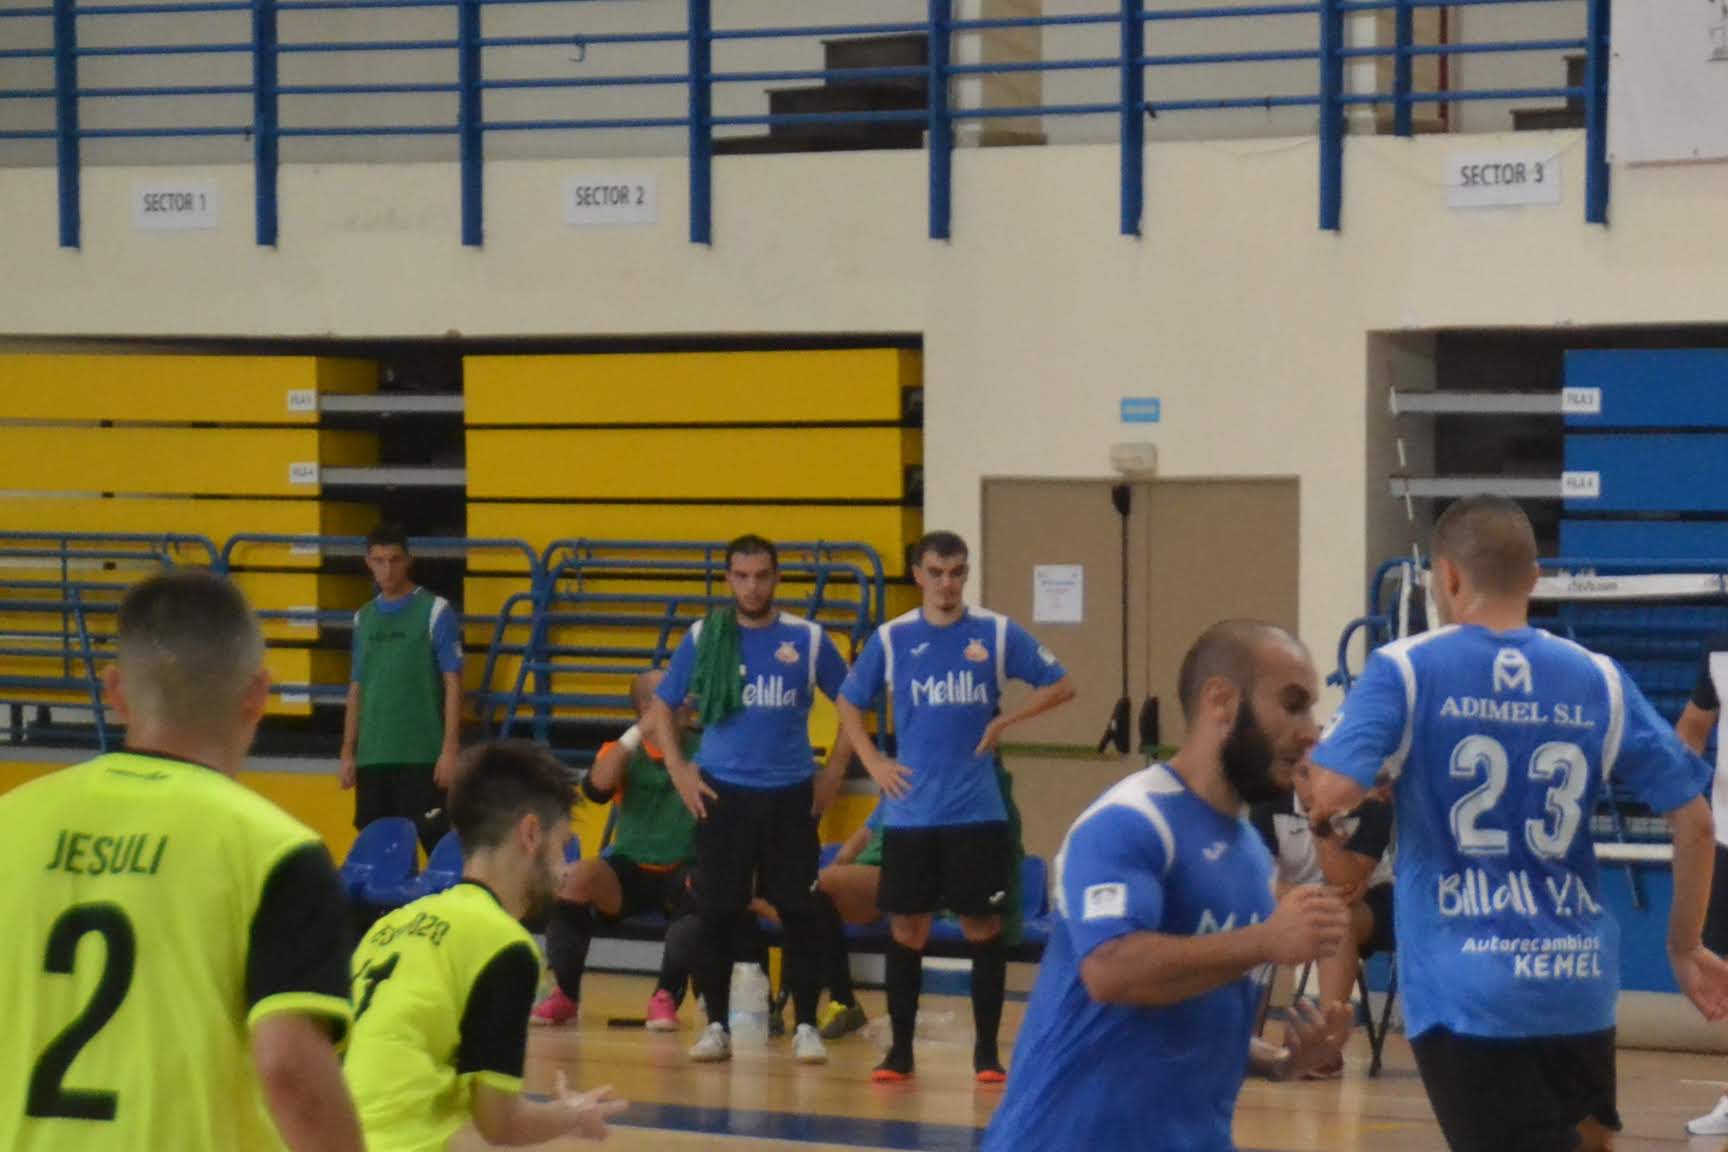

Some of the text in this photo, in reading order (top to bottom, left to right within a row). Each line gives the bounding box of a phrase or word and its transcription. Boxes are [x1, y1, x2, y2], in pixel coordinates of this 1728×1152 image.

[1460, 162, 1544, 187] SECTOR 3
[143, 193, 196, 212] SECTOR
[575, 185, 645, 206] SECTOR 2
[741, 665, 798, 707] elilla
[911, 669, 988, 706] Melilla
[1440, 696, 1549, 723] ADIMEL
[1449, 734, 1588, 859] 23
[46, 828, 168, 876] JESULI
[1461, 935, 1601, 953] Autorecambios
[1514, 952, 1602, 977] KEMEL
[25, 901, 137, 1122] 2
